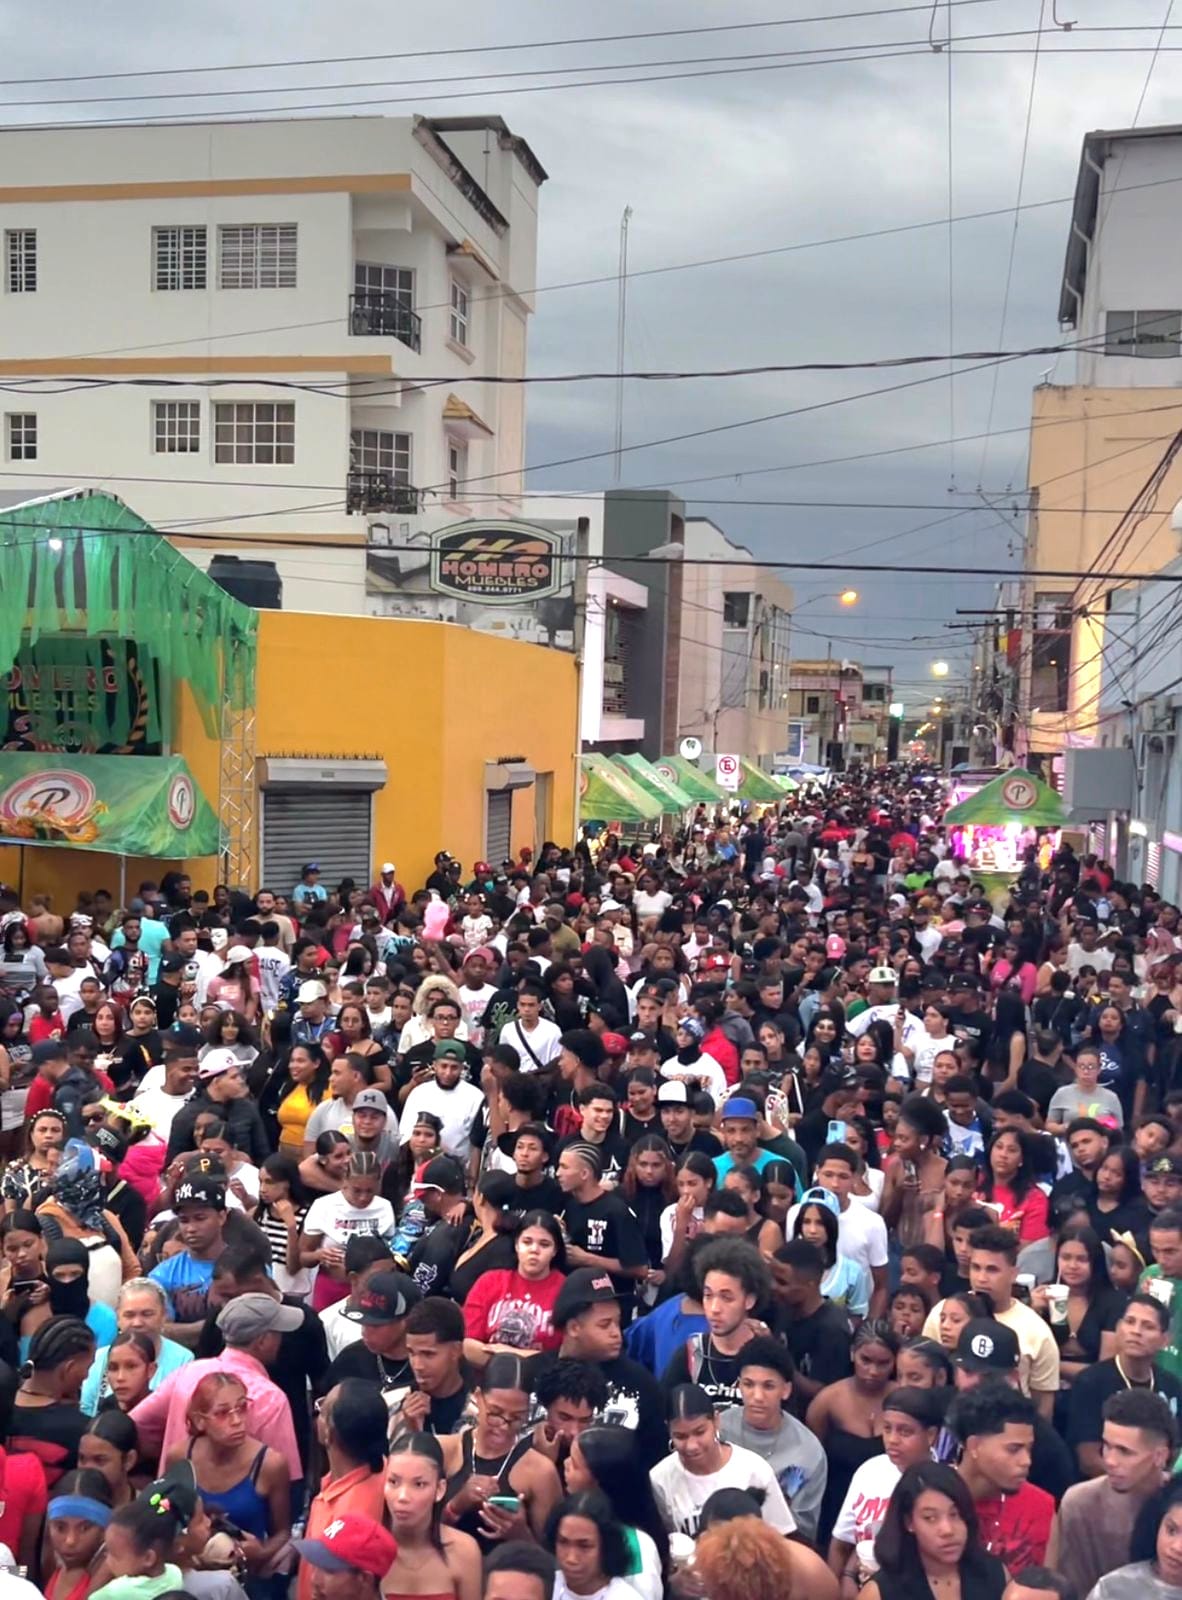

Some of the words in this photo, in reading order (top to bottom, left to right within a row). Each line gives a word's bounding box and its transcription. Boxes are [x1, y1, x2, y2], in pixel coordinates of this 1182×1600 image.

[441, 561, 549, 578] HOMERO
[455, 576, 538, 587] MUEBLES
[200, 1158, 210, 1172] P
